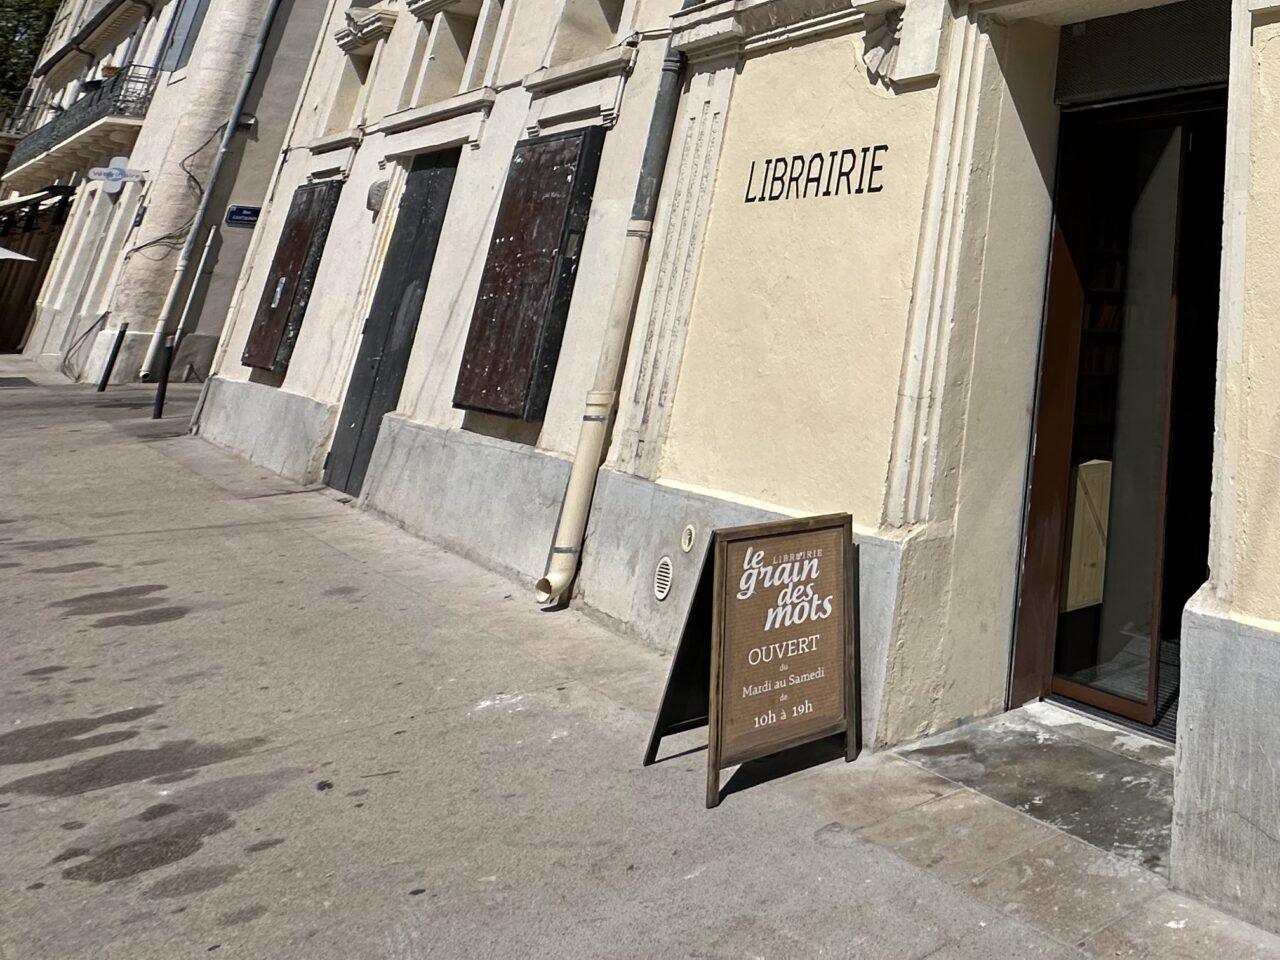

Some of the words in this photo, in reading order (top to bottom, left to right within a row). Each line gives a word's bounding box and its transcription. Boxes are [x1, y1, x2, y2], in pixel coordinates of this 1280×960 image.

[744, 144, 889, 203] LIBRAIRIE
[743, 546, 765, 571] le
[736, 553, 820, 600] grain
[777, 581, 815, 606] des
[764, 593, 834, 631] mots
[748, 634, 820, 666] OUVERT
[742, 680, 772, 698] Mardi
[774, 679, 787, 690] au
[788, 666, 825, 686] Samedi
[779, 663, 789, 672] du
[779, 693, 788, 702] de
[754, 710, 777, 728] 10h
[780, 708, 787, 720] à
[792, 700, 814, 718] 19h
